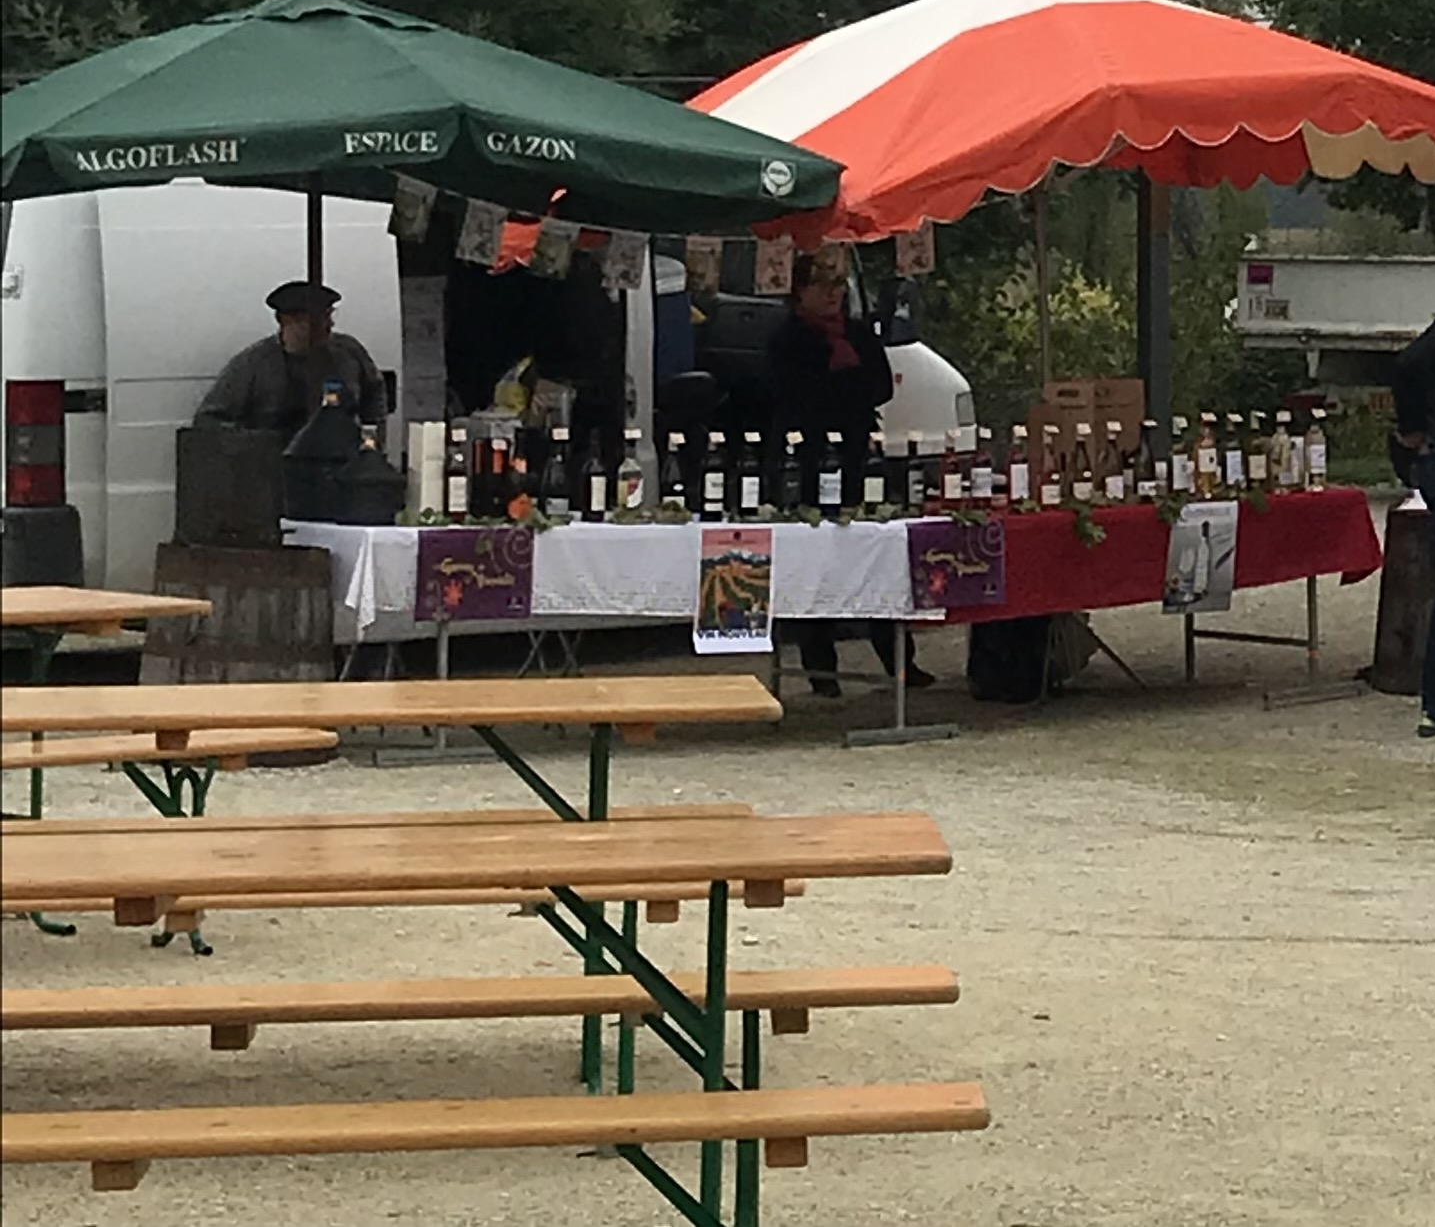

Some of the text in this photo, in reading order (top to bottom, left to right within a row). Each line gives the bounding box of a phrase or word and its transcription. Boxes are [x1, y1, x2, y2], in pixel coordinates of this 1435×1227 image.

[76, 139, 238, 171] ALGOFLASH
[345, 130, 576, 160] ESPACE GAZON
